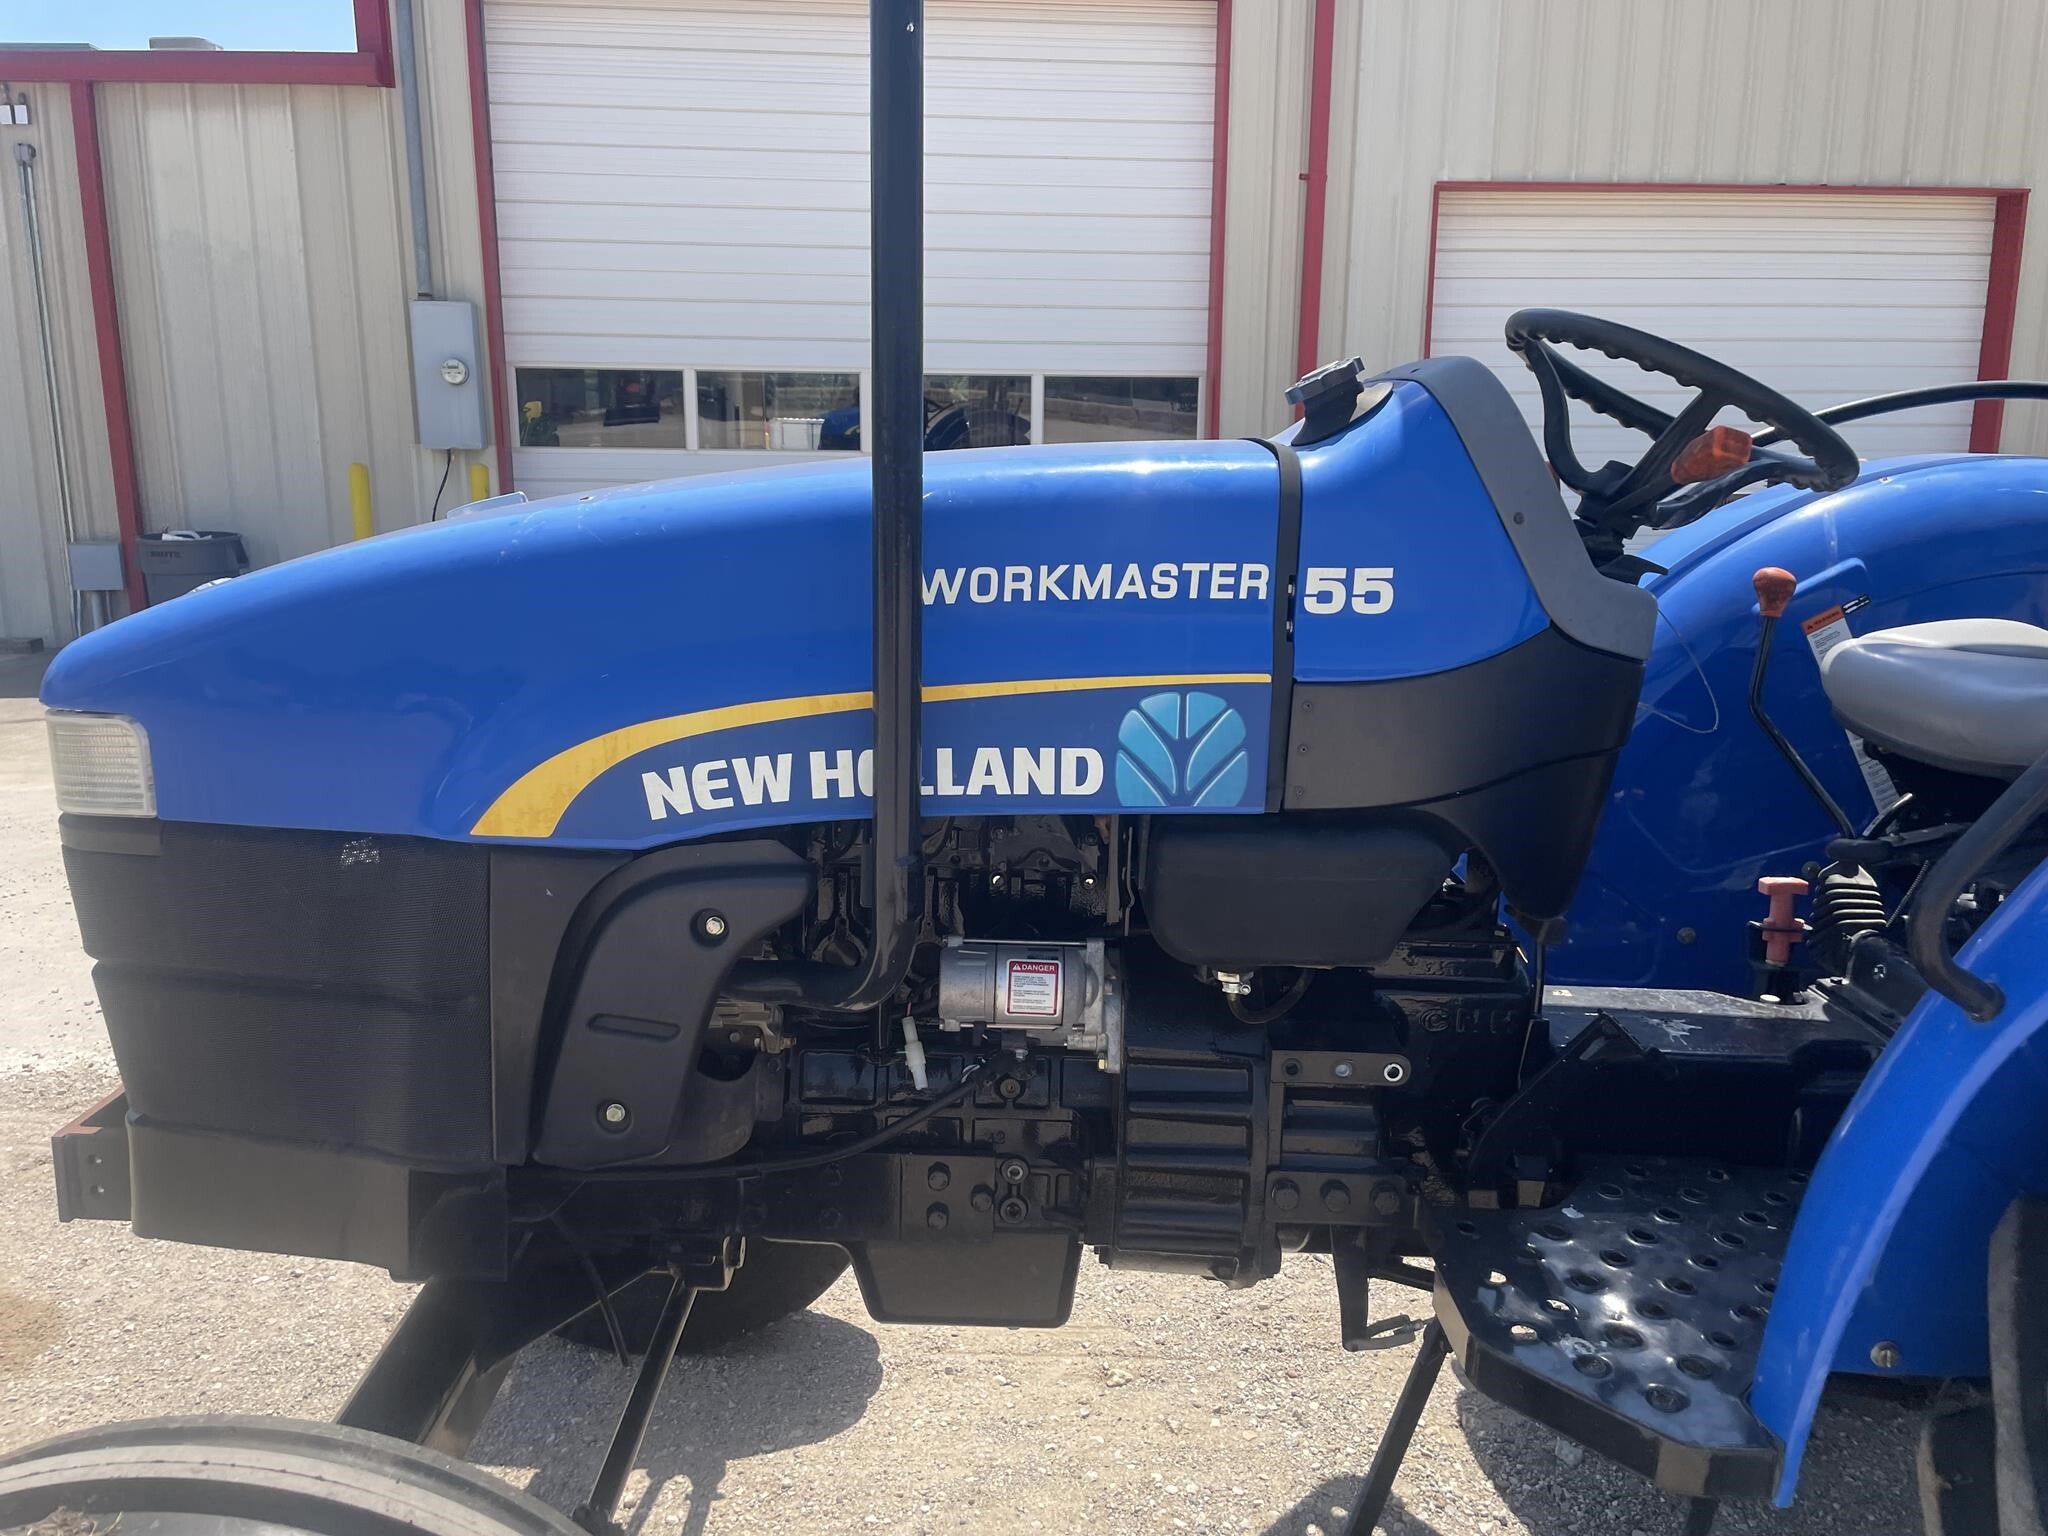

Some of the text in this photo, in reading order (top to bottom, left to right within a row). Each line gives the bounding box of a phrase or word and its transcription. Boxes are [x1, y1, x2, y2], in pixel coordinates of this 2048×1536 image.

[922, 563, 1395, 615] WORKMASTER 55
[641, 747, 1105, 821] NEW HLAND
